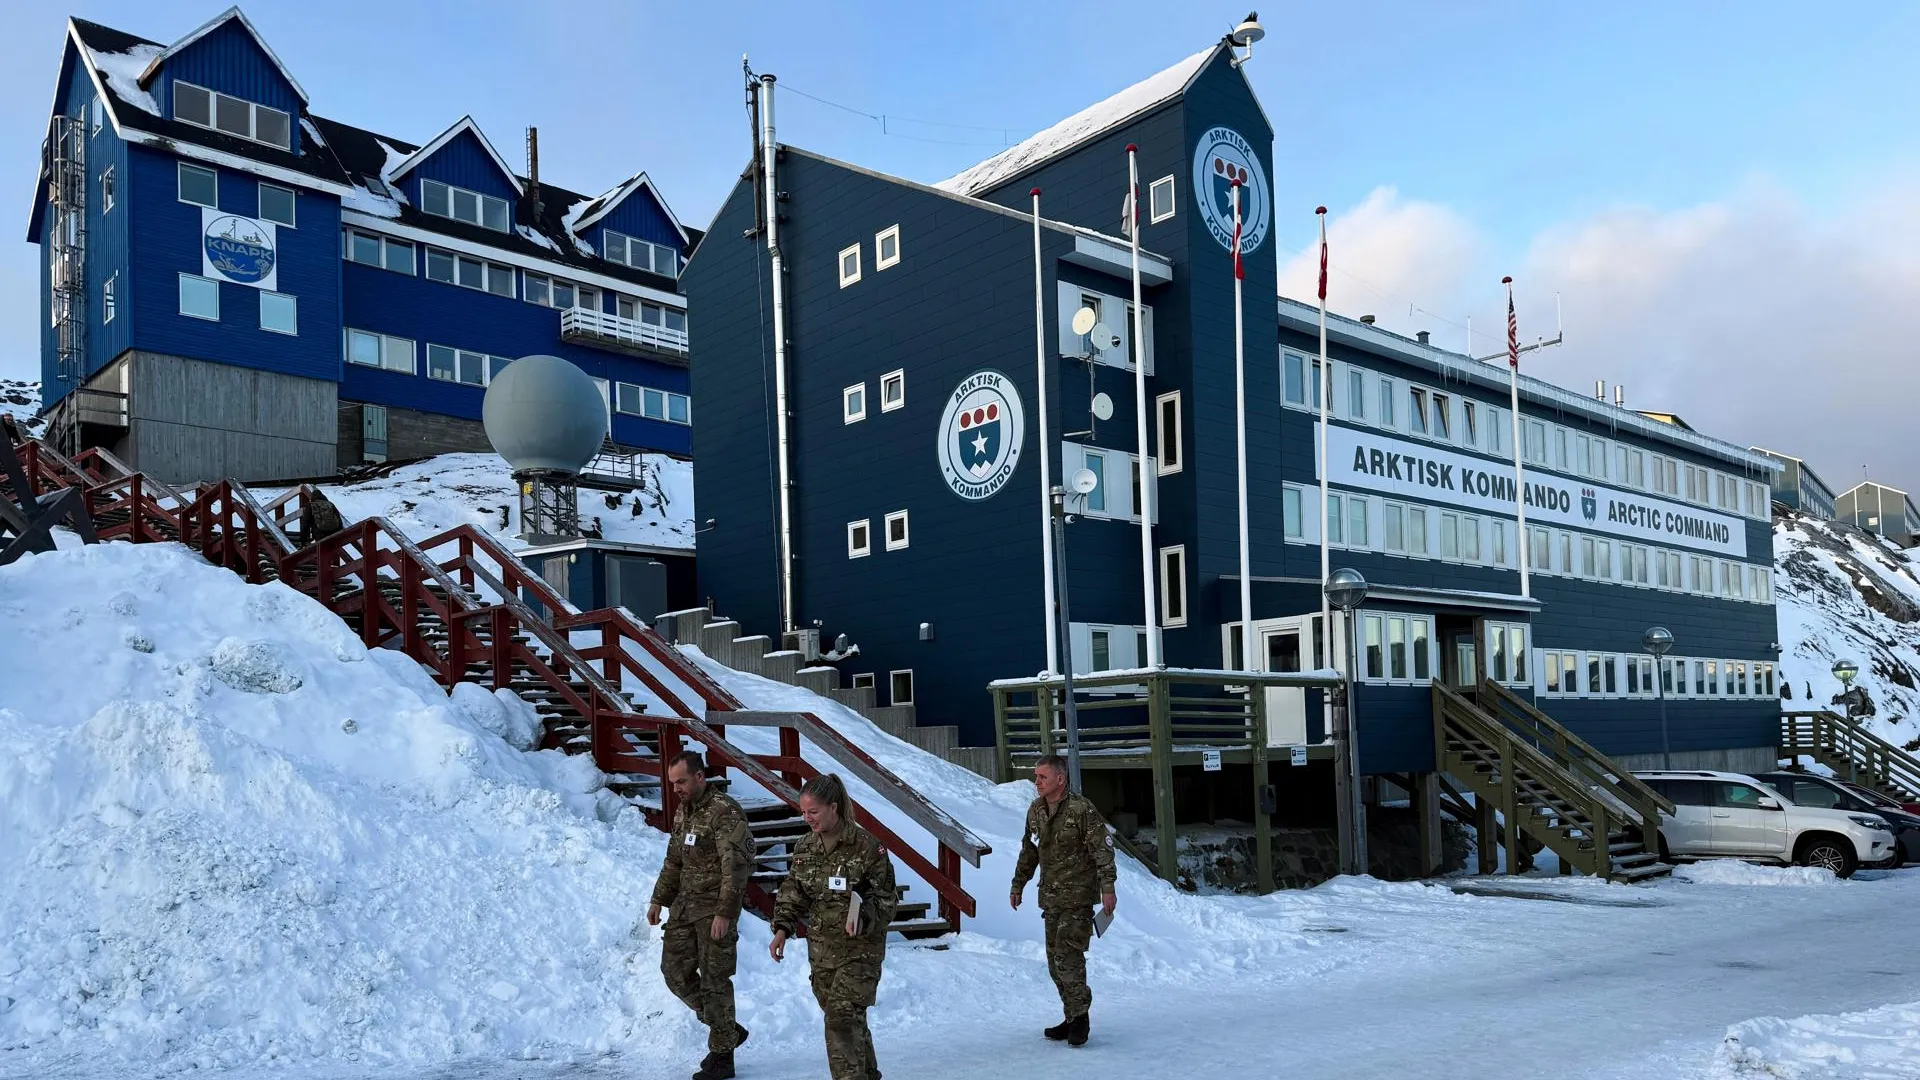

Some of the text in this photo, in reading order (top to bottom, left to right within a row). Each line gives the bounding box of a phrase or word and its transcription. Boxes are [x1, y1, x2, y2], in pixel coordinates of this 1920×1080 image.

[1209, 130, 1251, 157] ARKTISK
[1206, 215, 1260, 252] KOMMNDO
[208, 239, 273, 260] KNAPK
[954, 374, 1002, 403] ARKTISK
[951, 464, 1012, 498] KOMMANDO
[1353, 445, 1729, 544] ARKTISK KOMMANDO ARCTIC COMMAND
